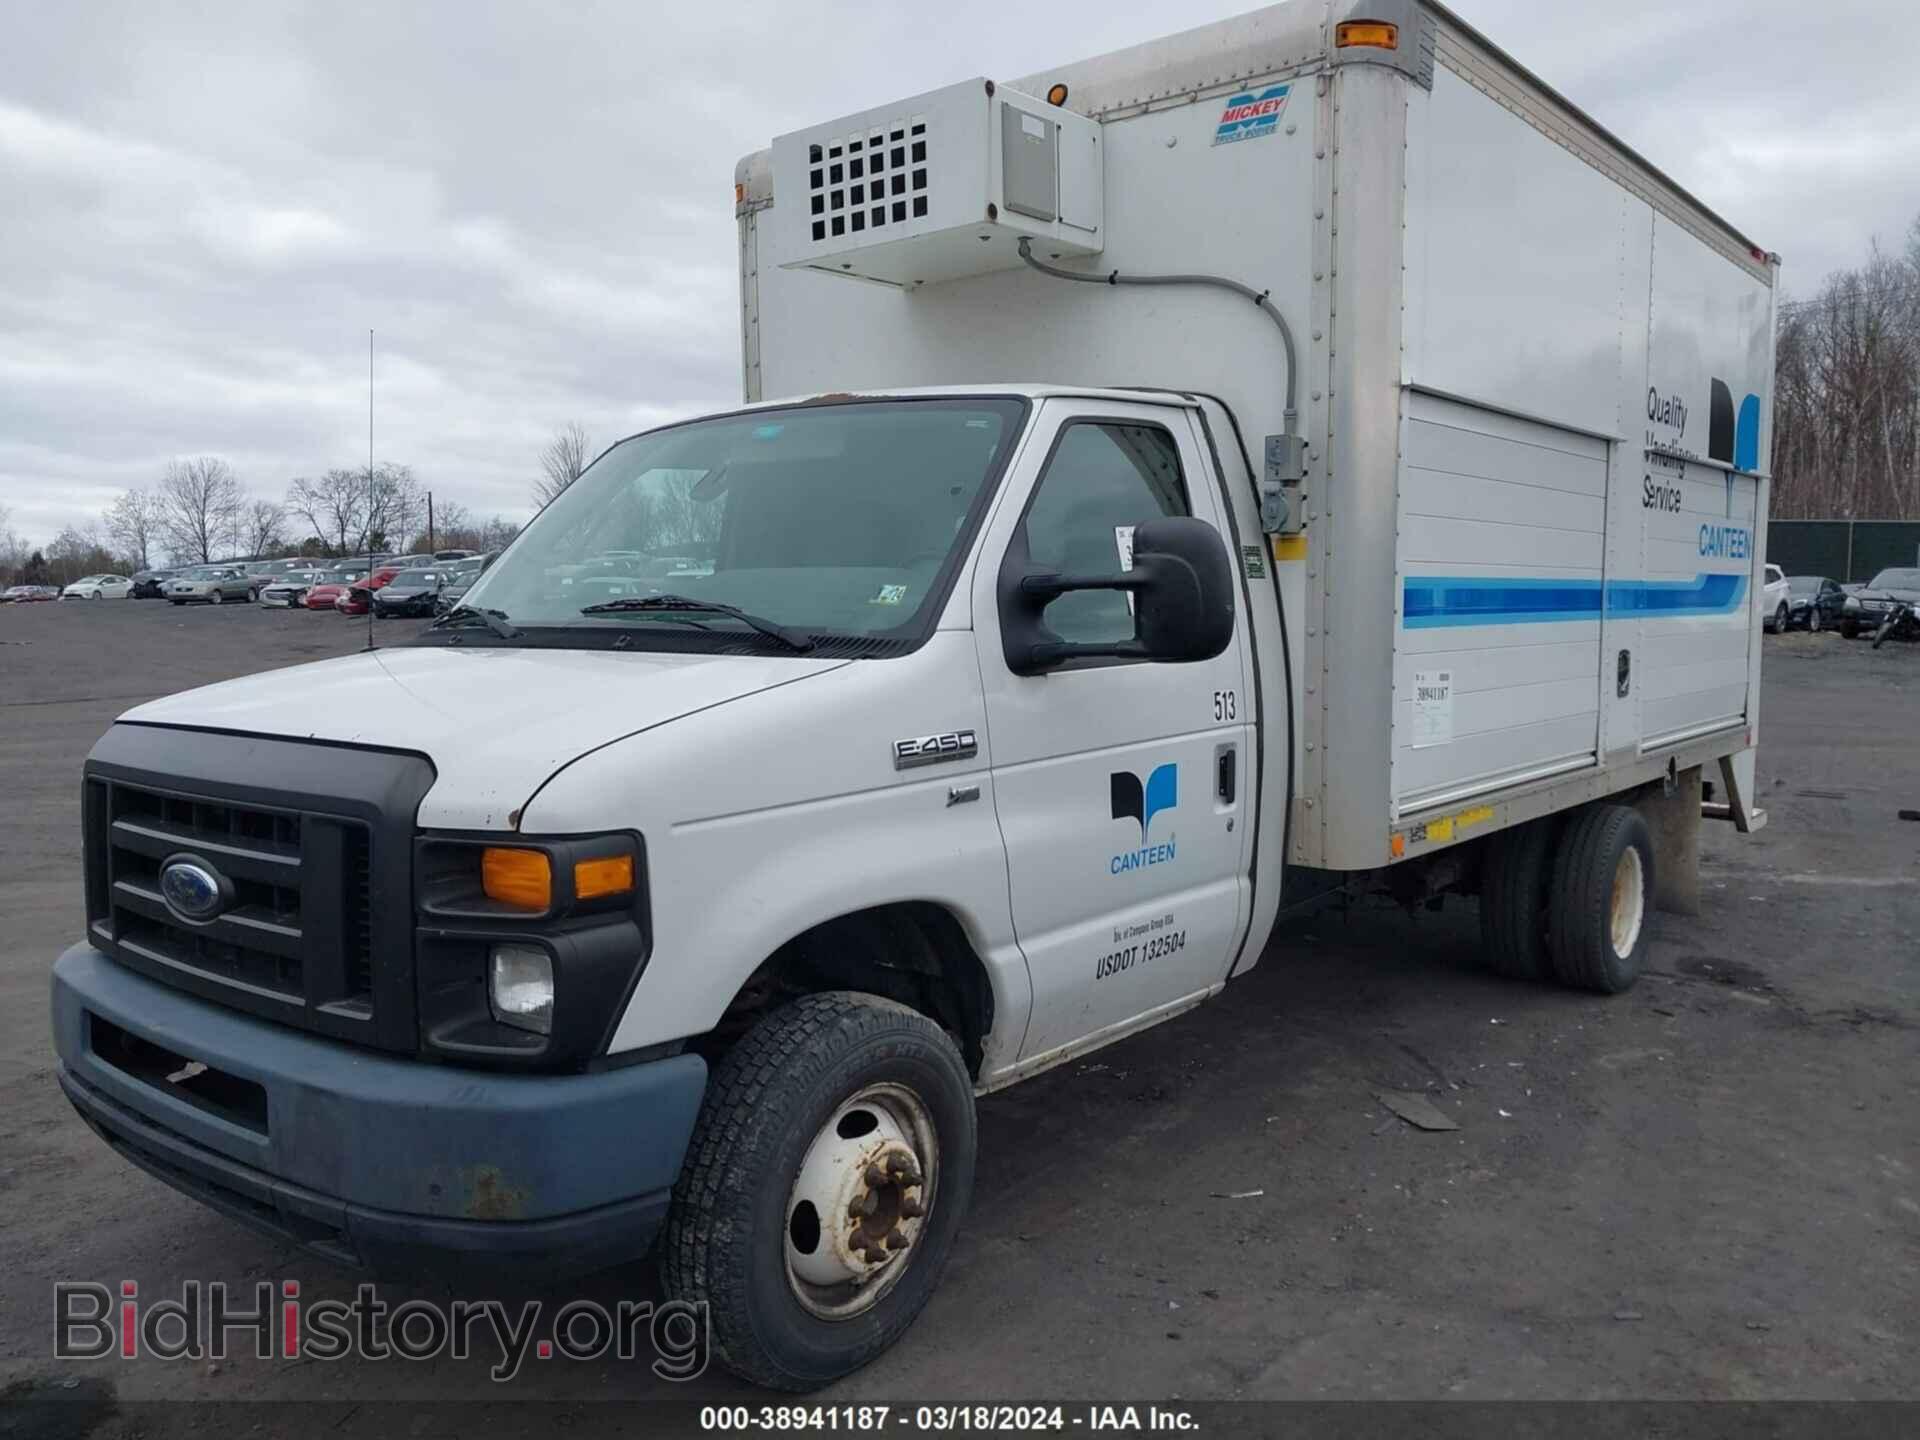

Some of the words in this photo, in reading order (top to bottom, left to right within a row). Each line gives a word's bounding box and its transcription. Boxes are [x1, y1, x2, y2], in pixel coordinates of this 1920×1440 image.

[1221, 97, 1285, 123] MICKEY
[1647, 386, 1688, 437] Quality
[1643, 475, 1682, 513] Service
[1699, 523, 1752, 559] CANTEEN
[1214, 690, 1236, 721] 513
[1111, 842, 1176, 875] CANTEEN
[1096, 946, 1138, 980] USDOT
[1142, 930, 1186, 963] 132504
